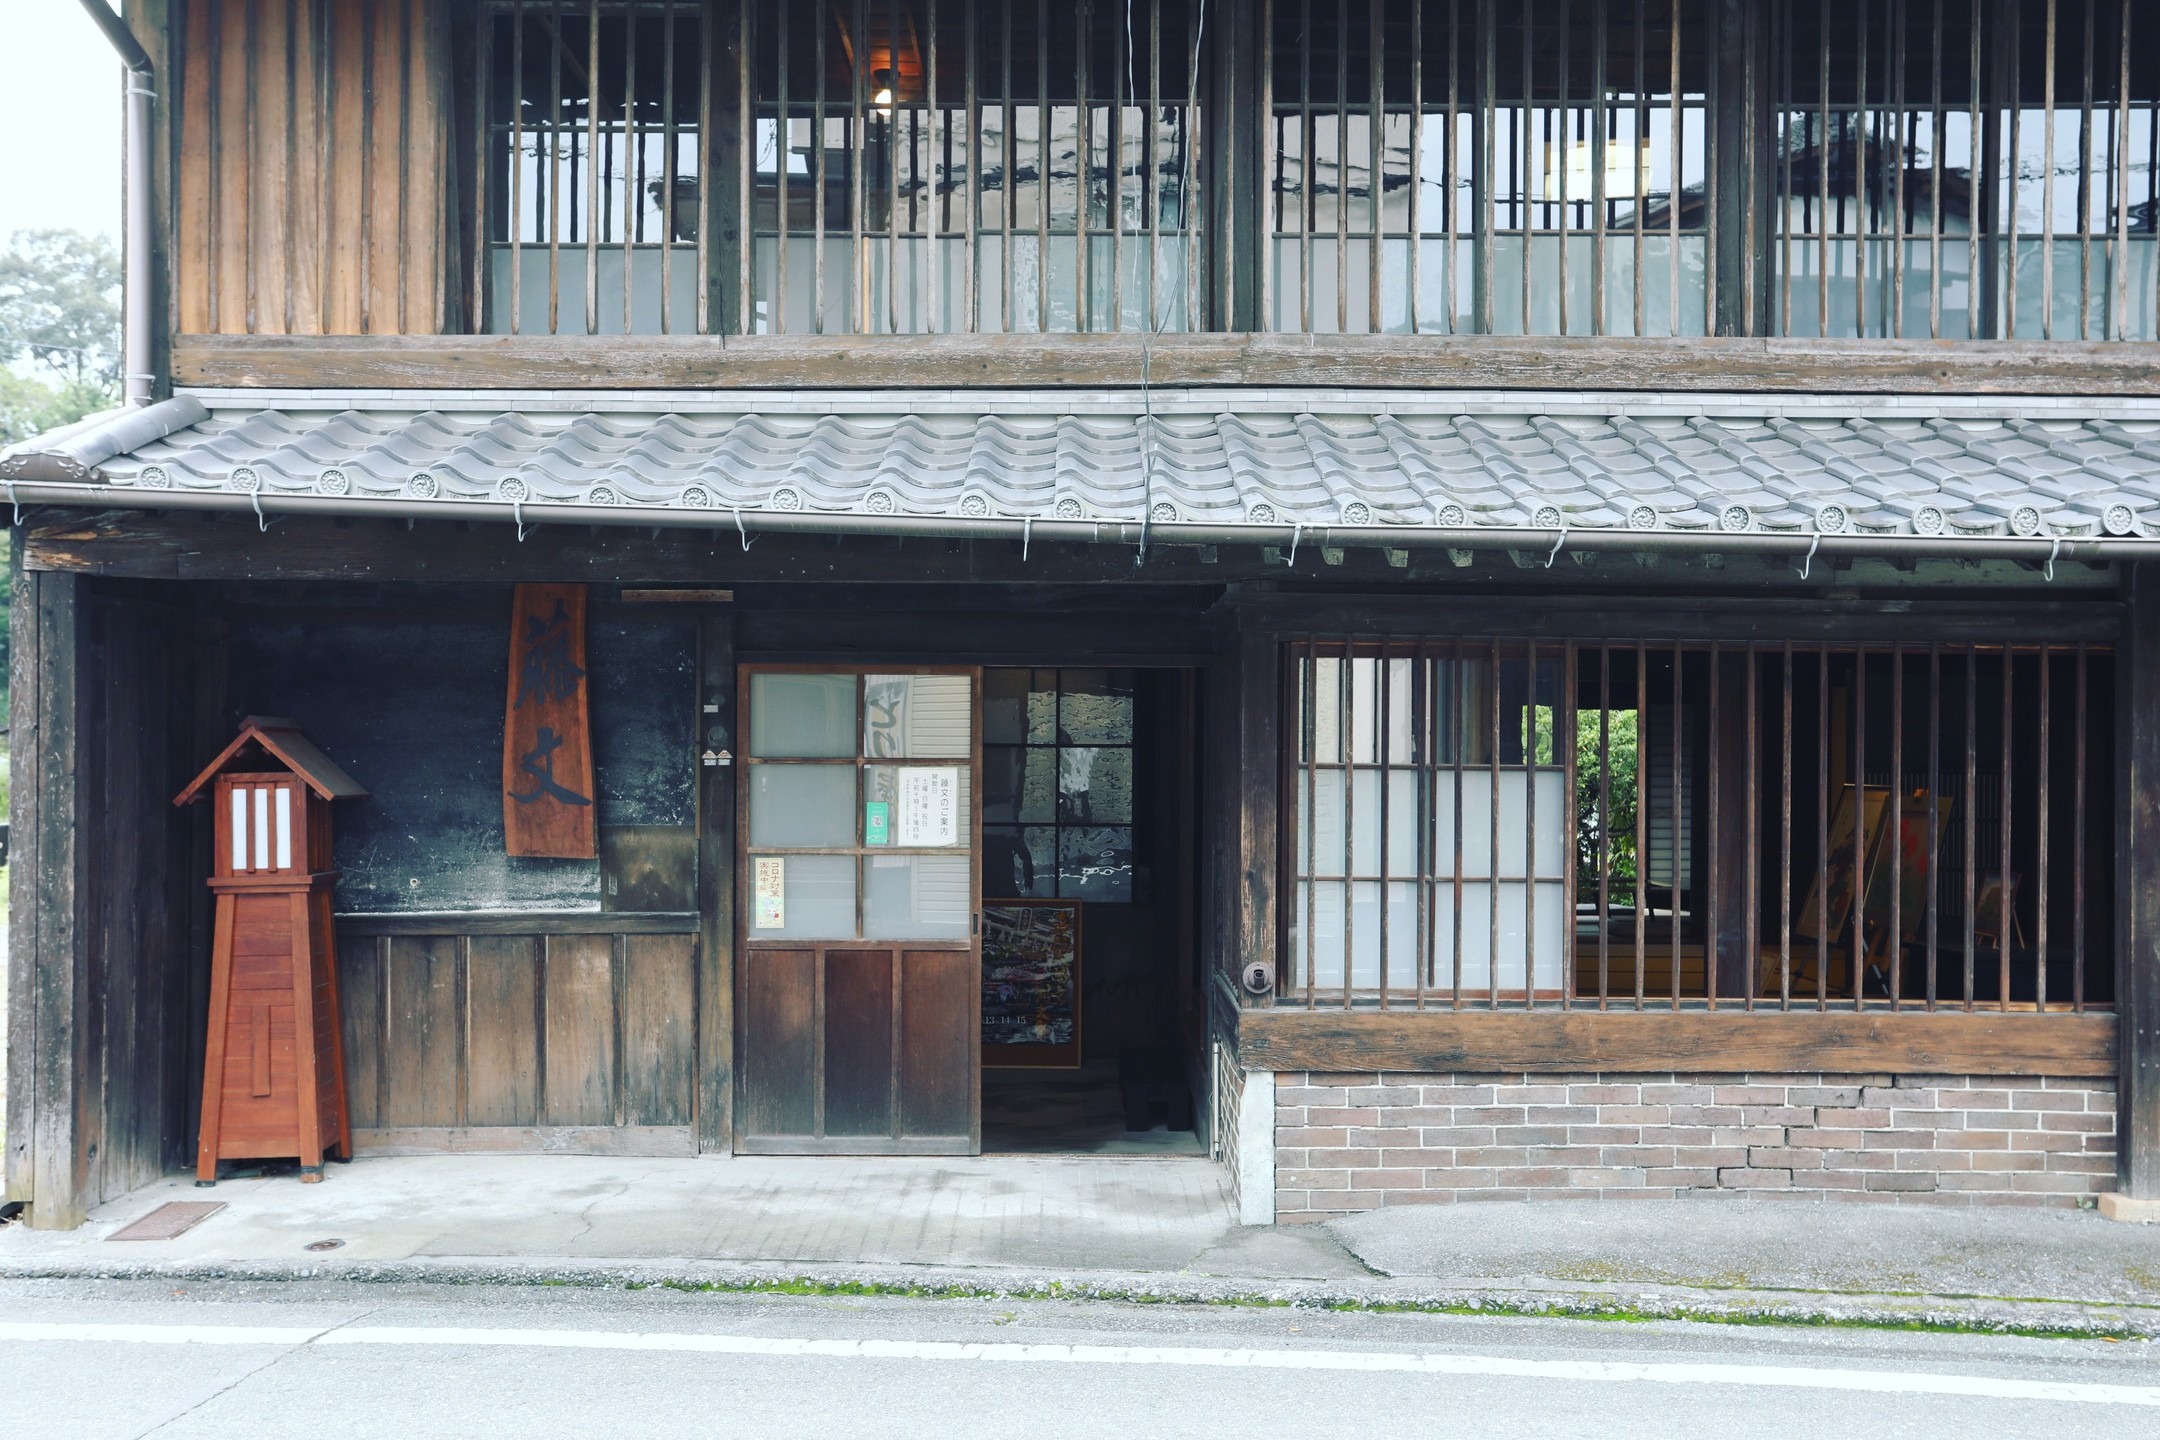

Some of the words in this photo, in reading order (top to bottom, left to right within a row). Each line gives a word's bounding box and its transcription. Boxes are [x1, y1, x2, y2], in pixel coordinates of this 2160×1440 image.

[507, 598, 593, 806] 藤文
[940, 778, 949, 837] 藤文のご案内
[758, 861, 770, 884] 実施中
[769, 861, 780, 897] コロナ対策
